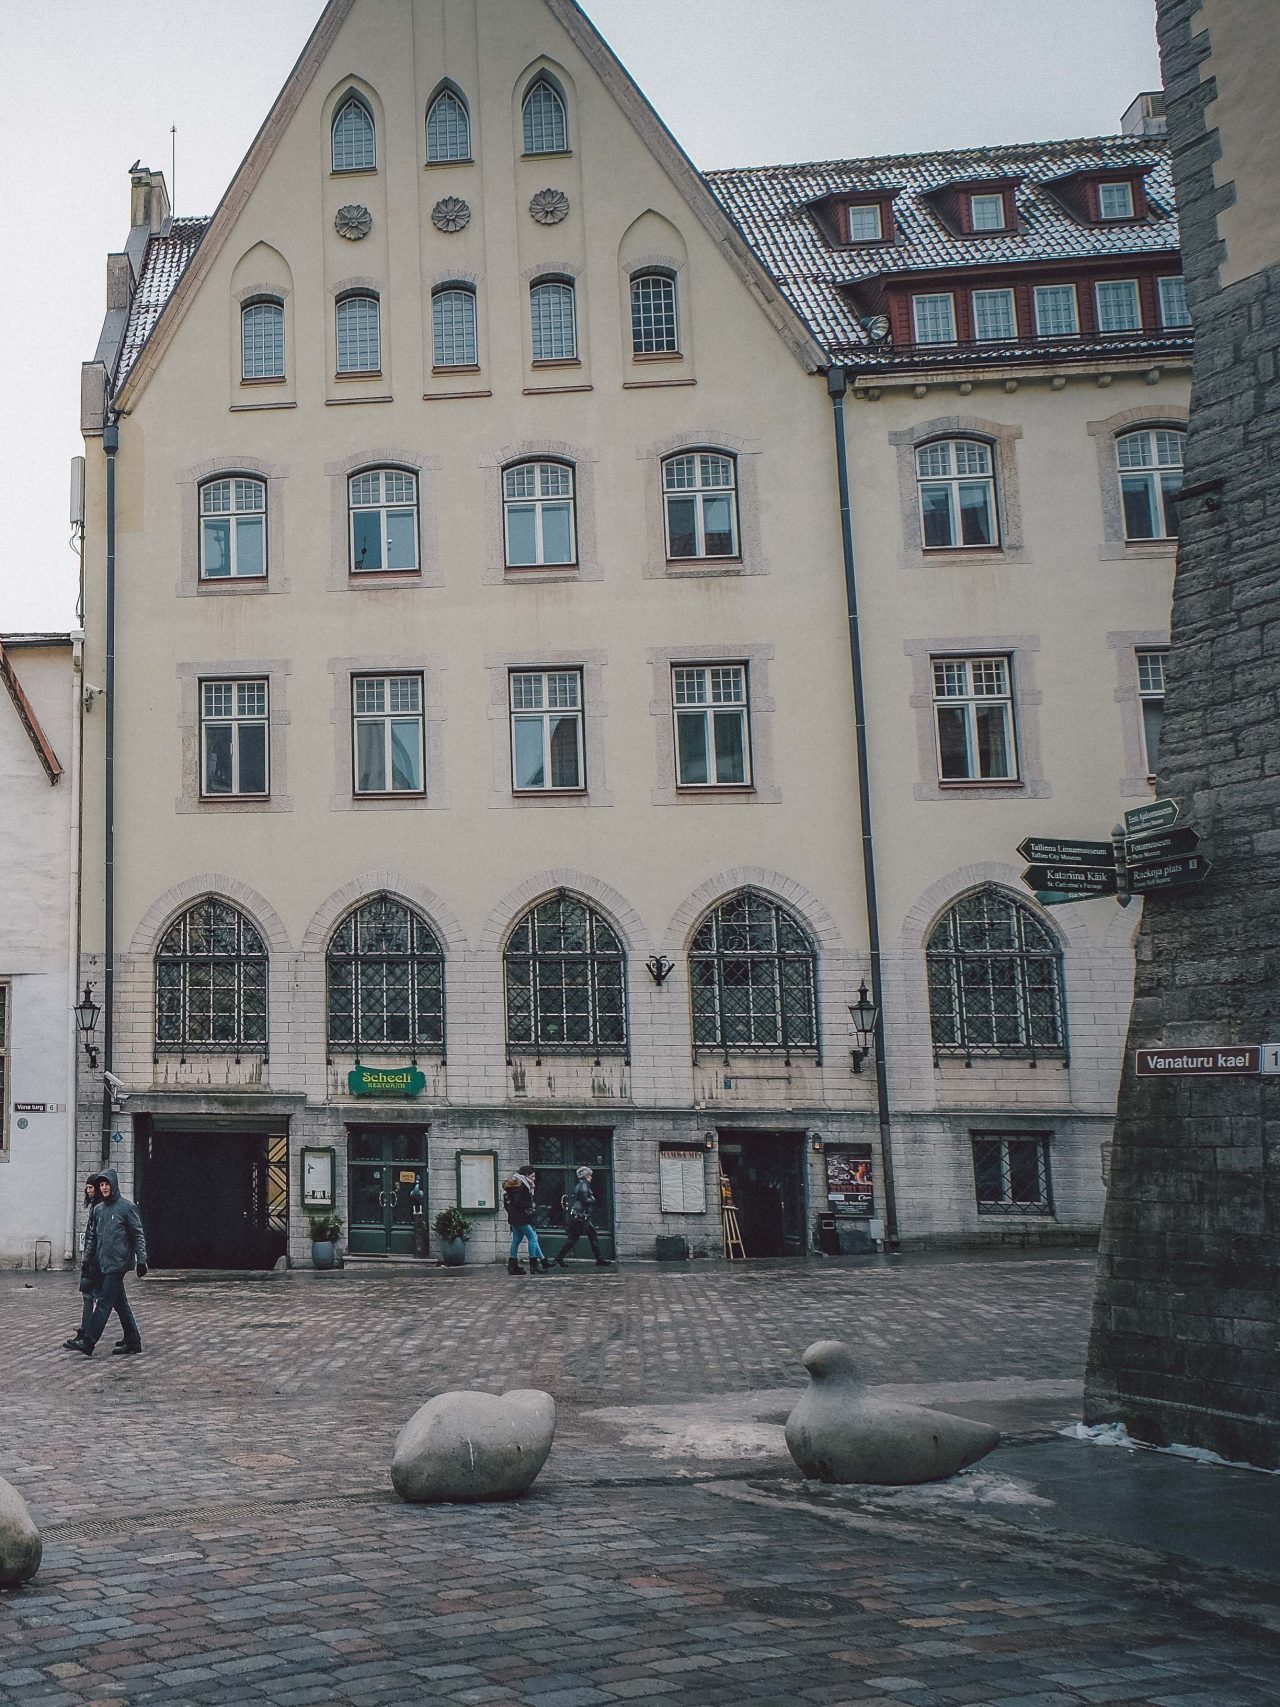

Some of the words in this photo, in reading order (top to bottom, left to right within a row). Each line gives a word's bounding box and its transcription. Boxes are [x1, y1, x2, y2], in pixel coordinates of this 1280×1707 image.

[1030, 843, 1057, 852] Tallinna
[1147, 1055, 1213, 1069] Vanaturu
[1217, 1052, 1250, 1067] kael
